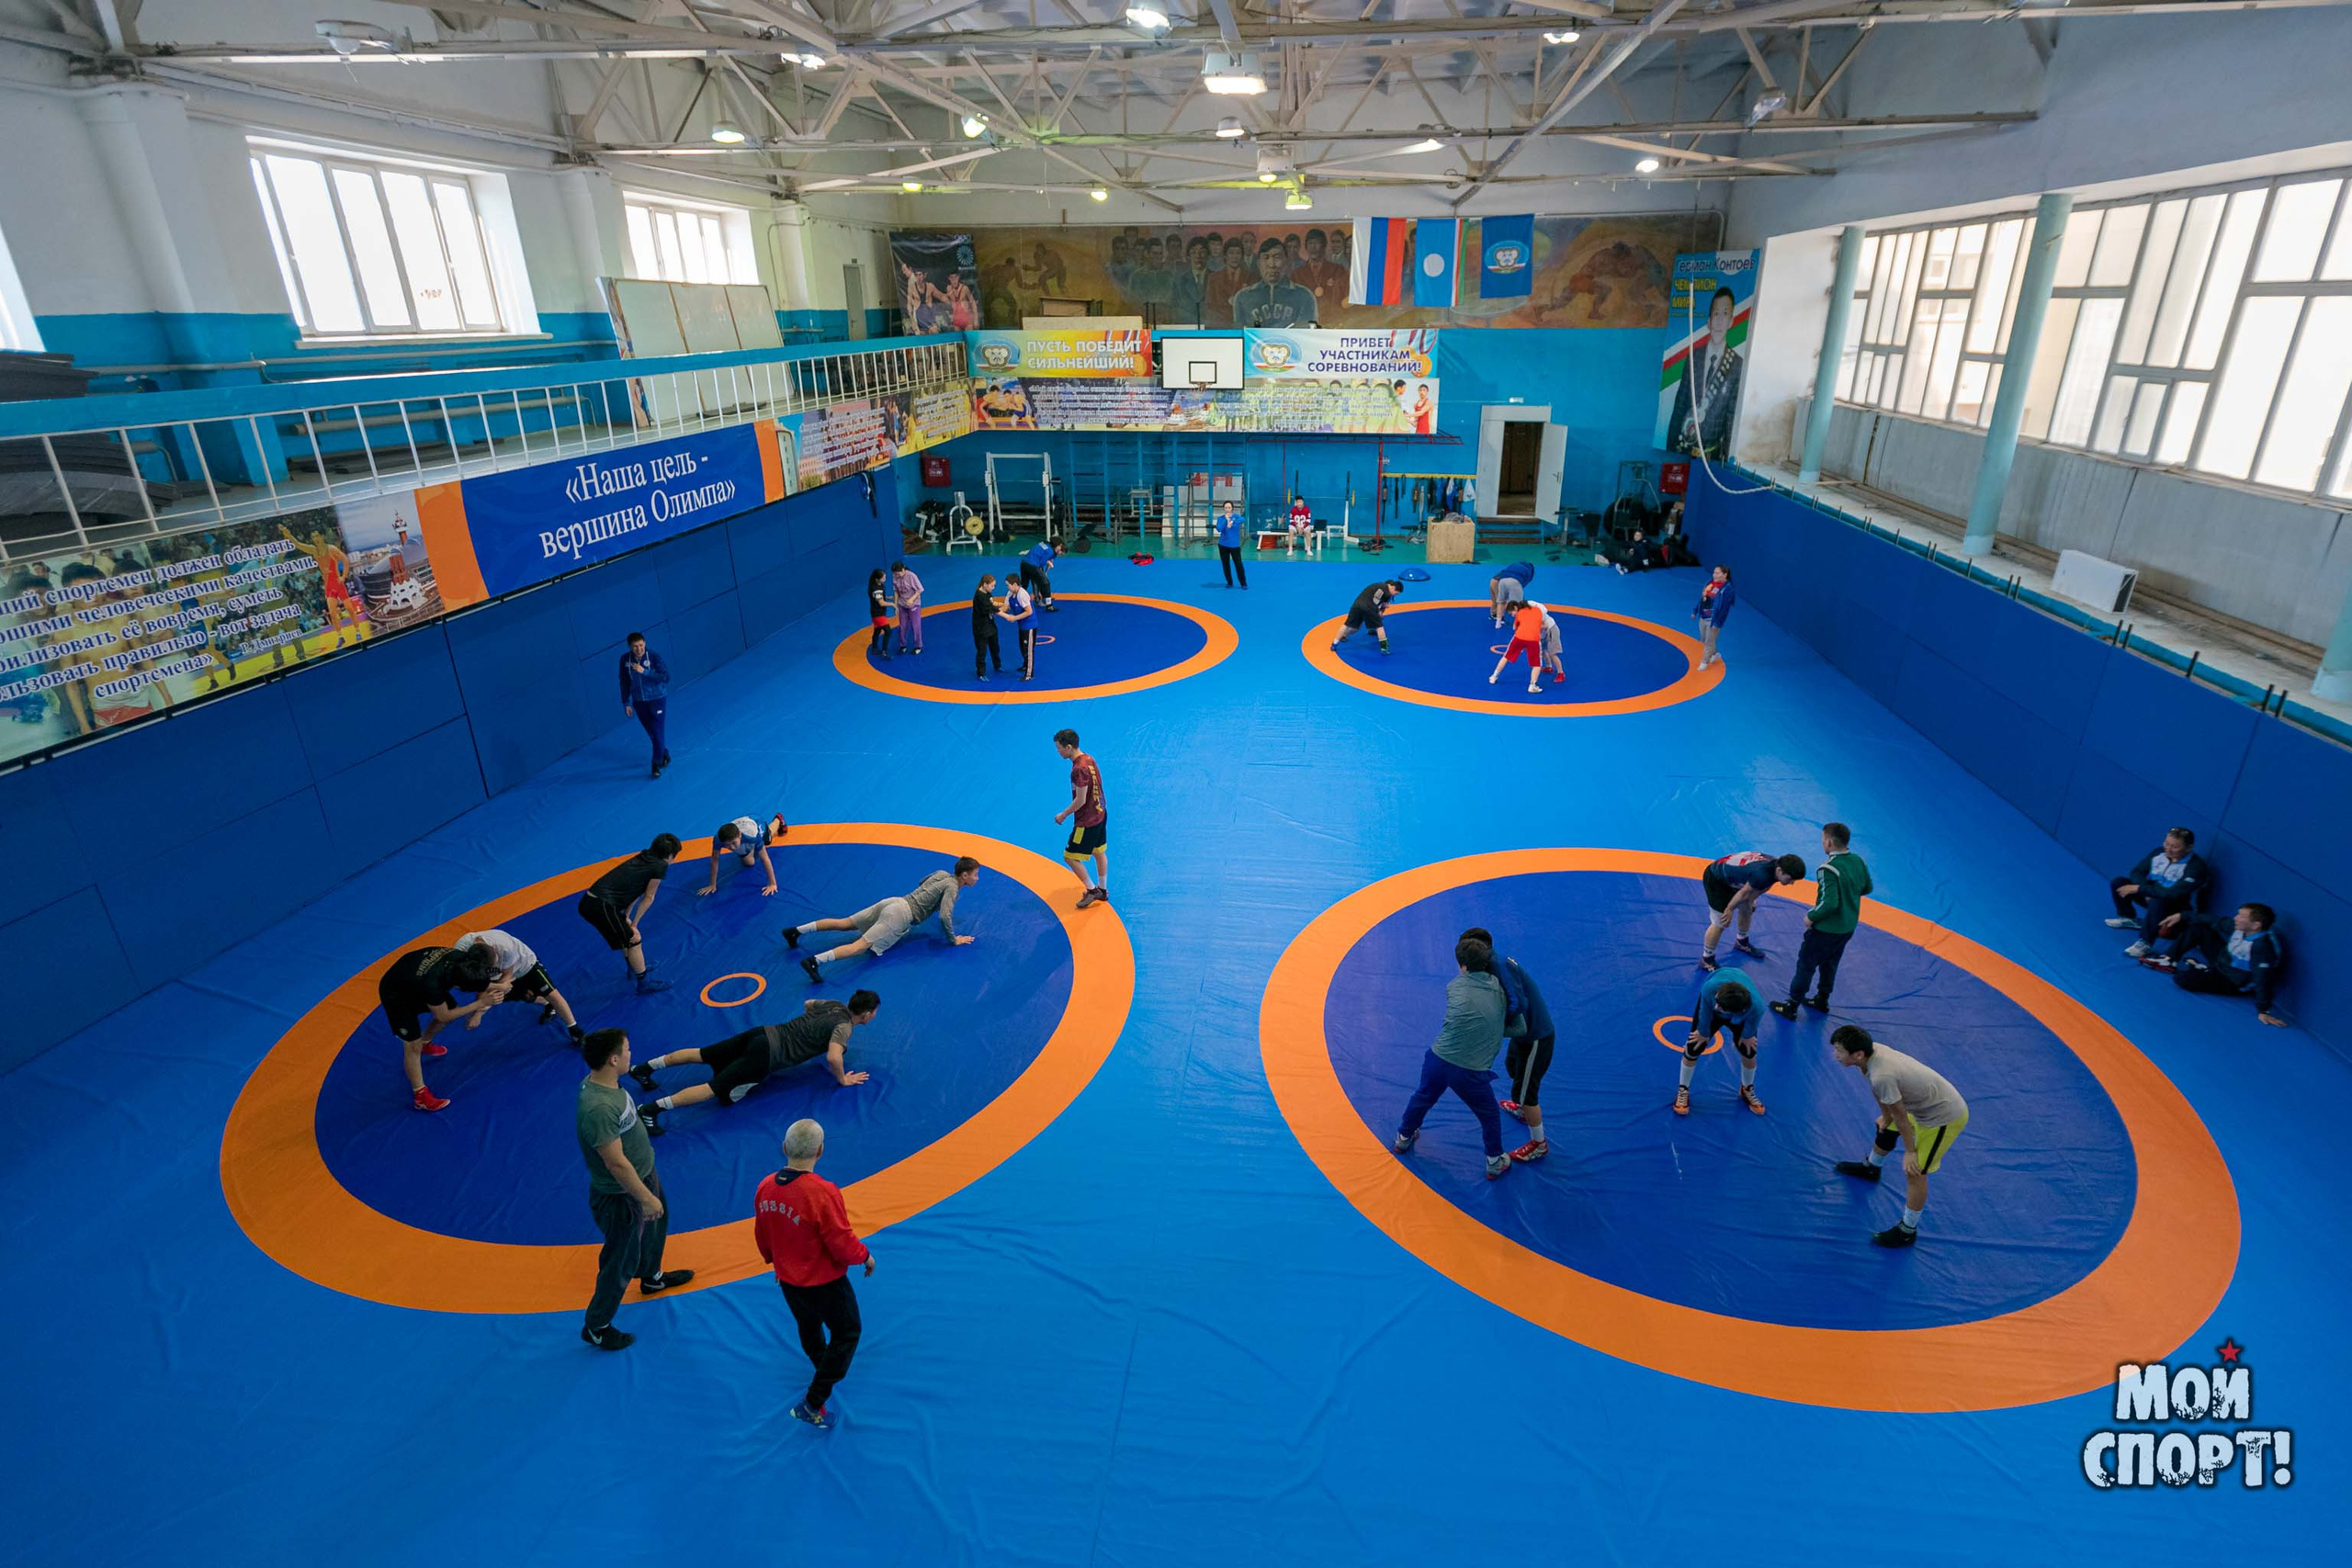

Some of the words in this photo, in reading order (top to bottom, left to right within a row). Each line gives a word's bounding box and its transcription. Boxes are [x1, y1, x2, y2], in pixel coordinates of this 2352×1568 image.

[1026, 341, 1071, 353] ПУСТЬ
[1076, 341, 1141, 354] ПОБЕДИТ
[1027, 355, 1134, 369] СИЛЬНЕЙШИЙ!
[1307, 361, 1421, 373] СОРЕВНОВАНИЙ!
[1320, 350, 1410, 360] УЧАСТНИКАМ
[1340, 338, 1391, 348] ПРИВЕТ
[565, 461, 647, 503] «Наша
[650, 452, 696, 485] цель
[539, 504, 648, 559] вершина
[651, 479, 735, 522] Олимпа»
[47, 570, 153, 604] спортсмен
[158, 556, 221, 582] должен
[224, 539, 295, 564] обладать
[77, 580, 220, 623] человеческими
[223, 556, 318, 588] качествами.
[121, 621, 141, 638] её
[146, 603, 226, 632] вовремя,
[228, 587, 282, 613] суметь
[0, 662, 99, 701] льзовать
[103, 631, 207, 671] правильно
[219, 619, 248, 637] вот
[252, 604, 301, 627] задача
[95, 653, 213, 698] спортсмена»
